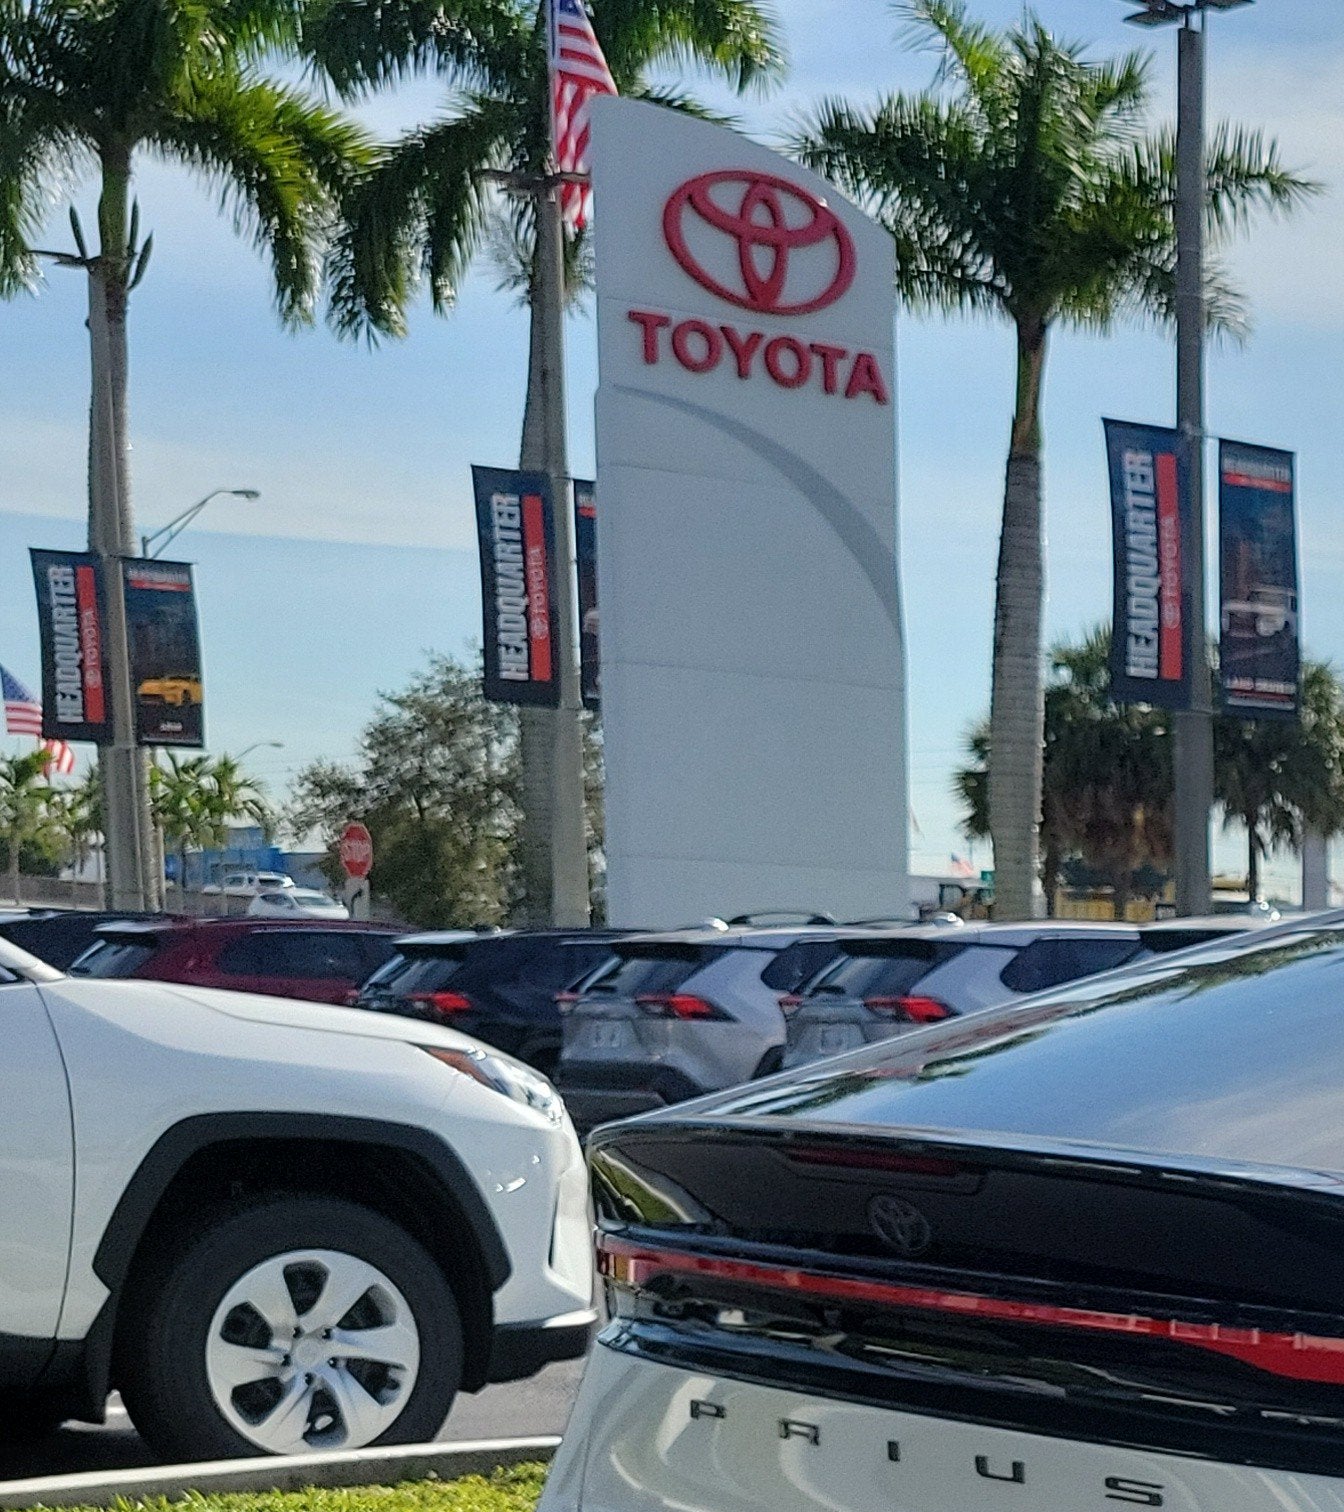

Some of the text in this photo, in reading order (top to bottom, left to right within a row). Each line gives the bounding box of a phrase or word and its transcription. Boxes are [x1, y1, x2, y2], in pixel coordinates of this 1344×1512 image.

[627, 310, 889, 406] TOYOTA
[491, 492, 529, 682] HEADQUARTER
[526, 547, 547, 614] TOYOTA
[1123, 451, 1160, 680] HEADQUARTER
[1160, 515, 1179, 598] TOYOTA
[48, 566, 84, 723] HEADQUARTER
[80, 609, 99, 667] TOYOTA
[690, 1398, 1165, 1507] PRIUS
